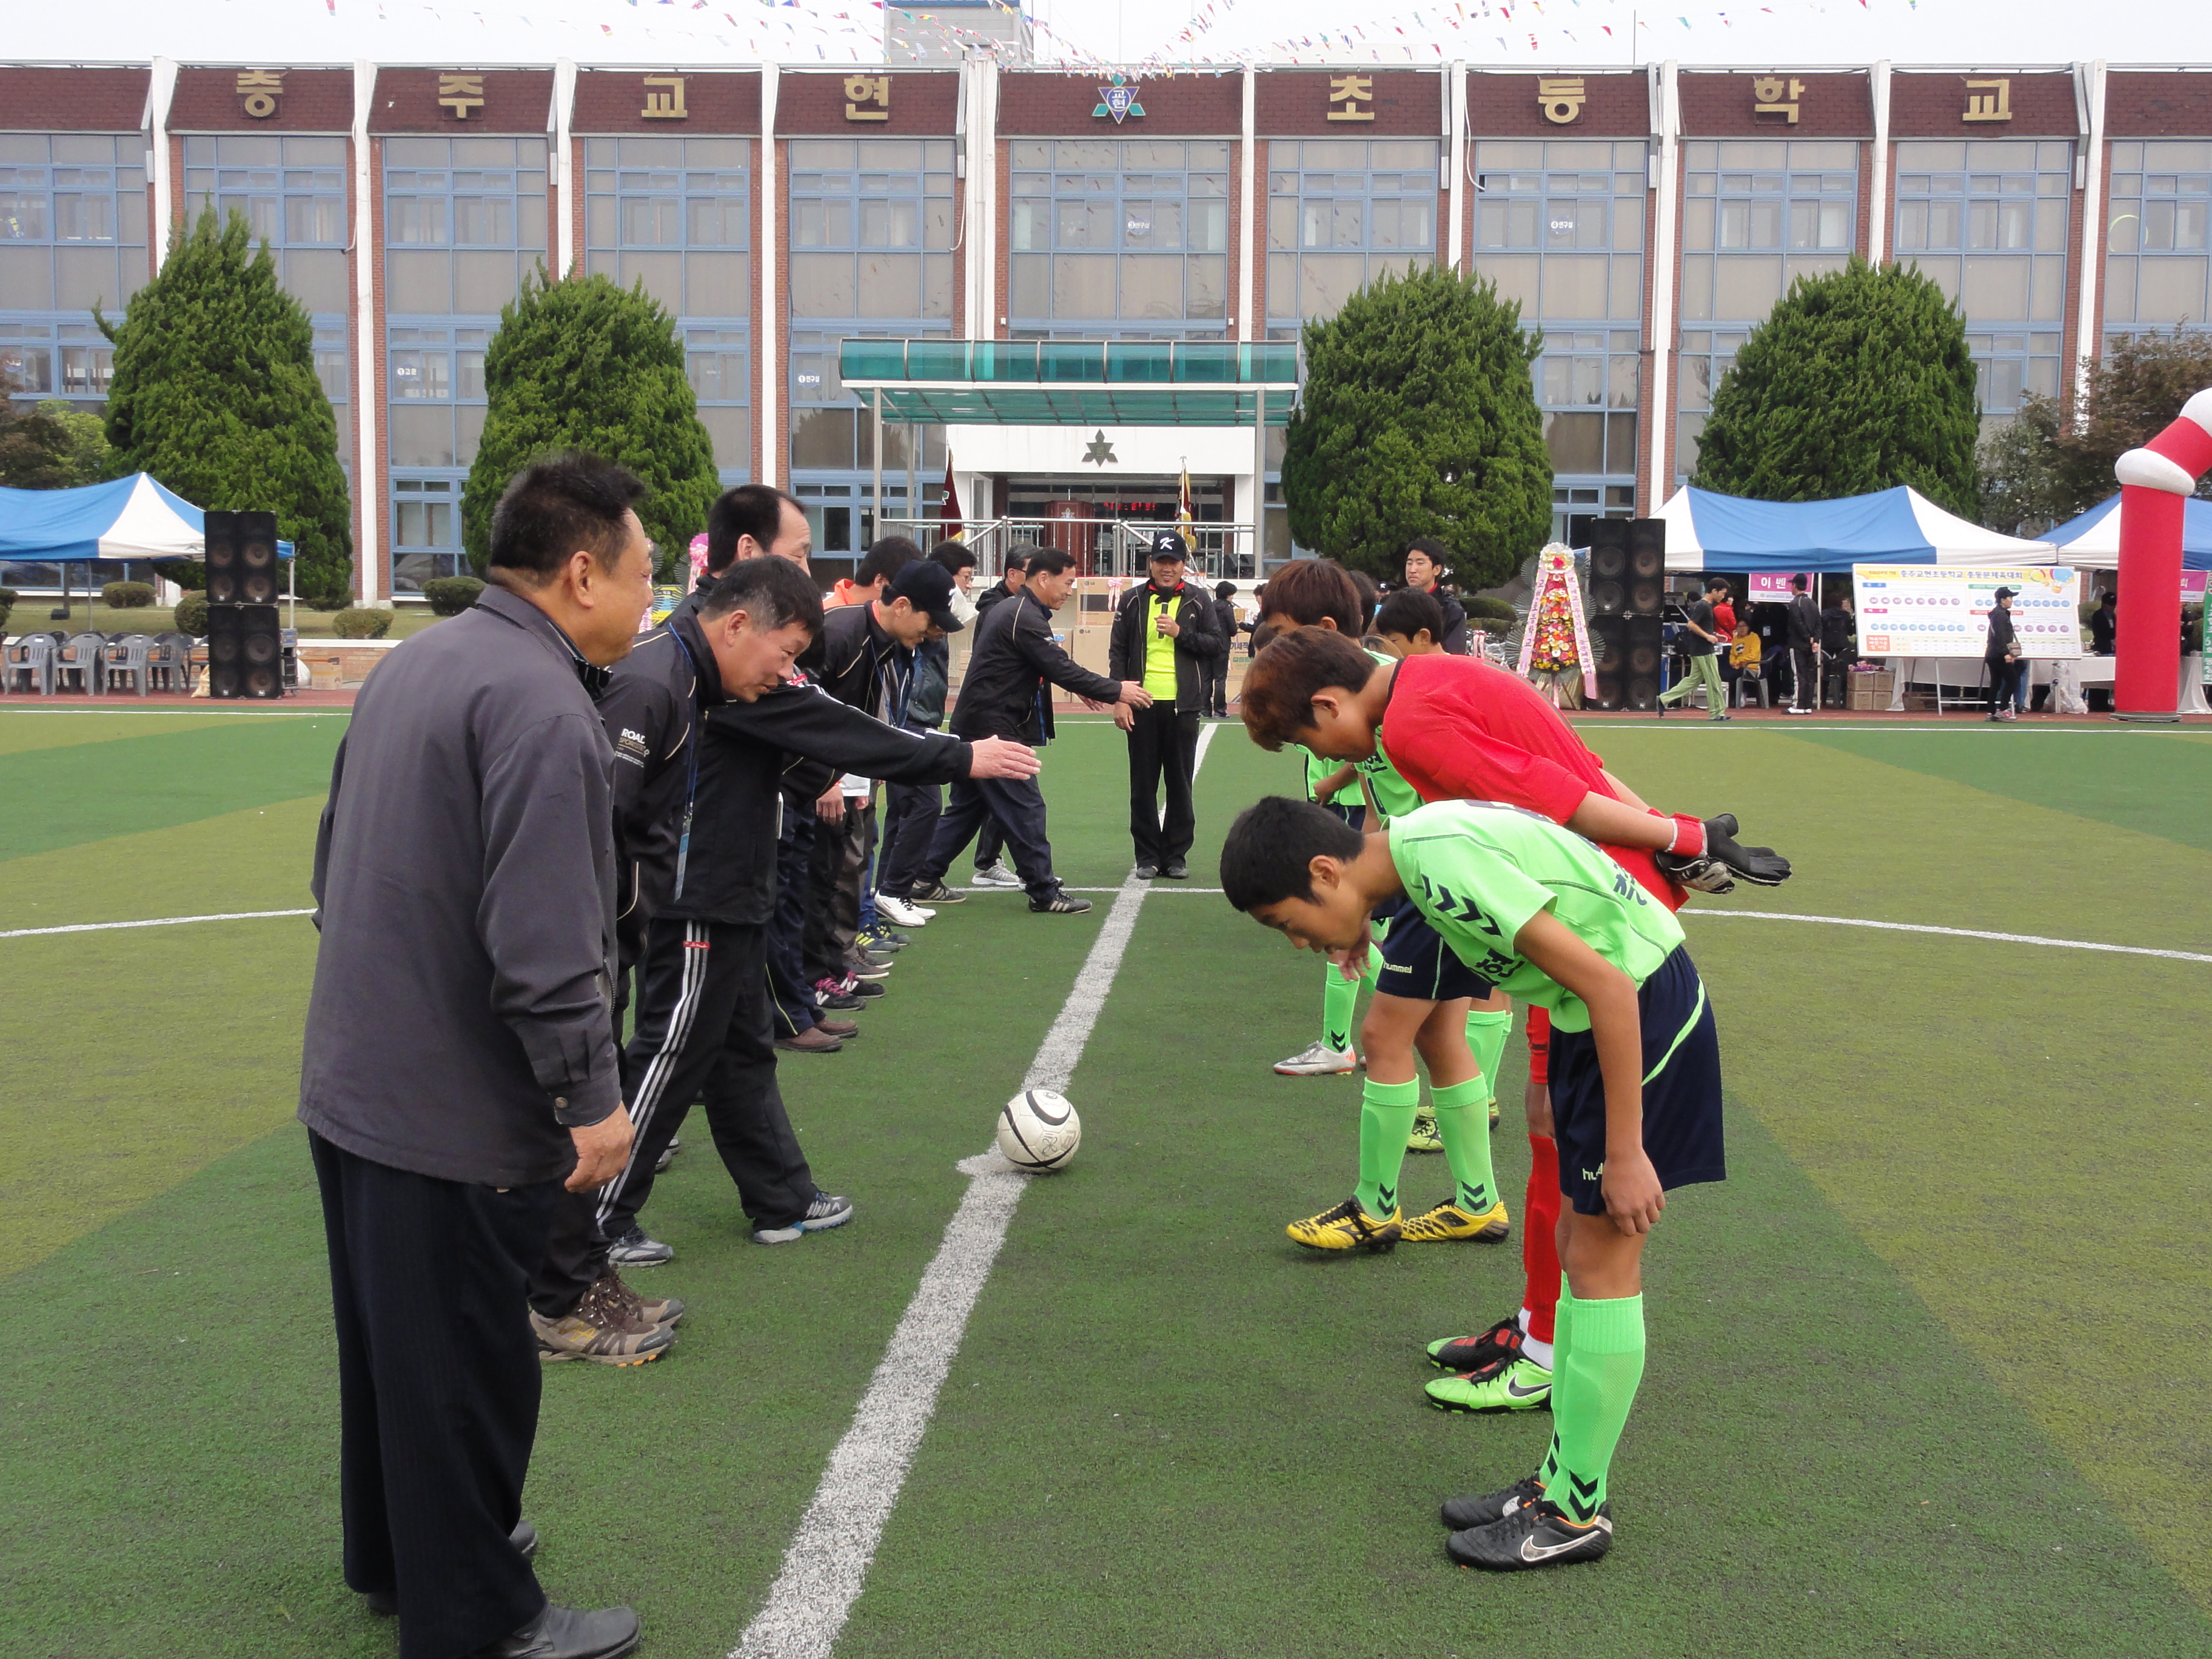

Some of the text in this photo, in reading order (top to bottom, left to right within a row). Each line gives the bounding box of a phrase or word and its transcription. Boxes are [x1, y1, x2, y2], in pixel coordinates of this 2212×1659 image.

[236, 70, 2012, 124] 충 주 교 현 초 등 학 교
[1159, 536, 1175, 551] K
[1383, 960, 1413, 974] hummel
